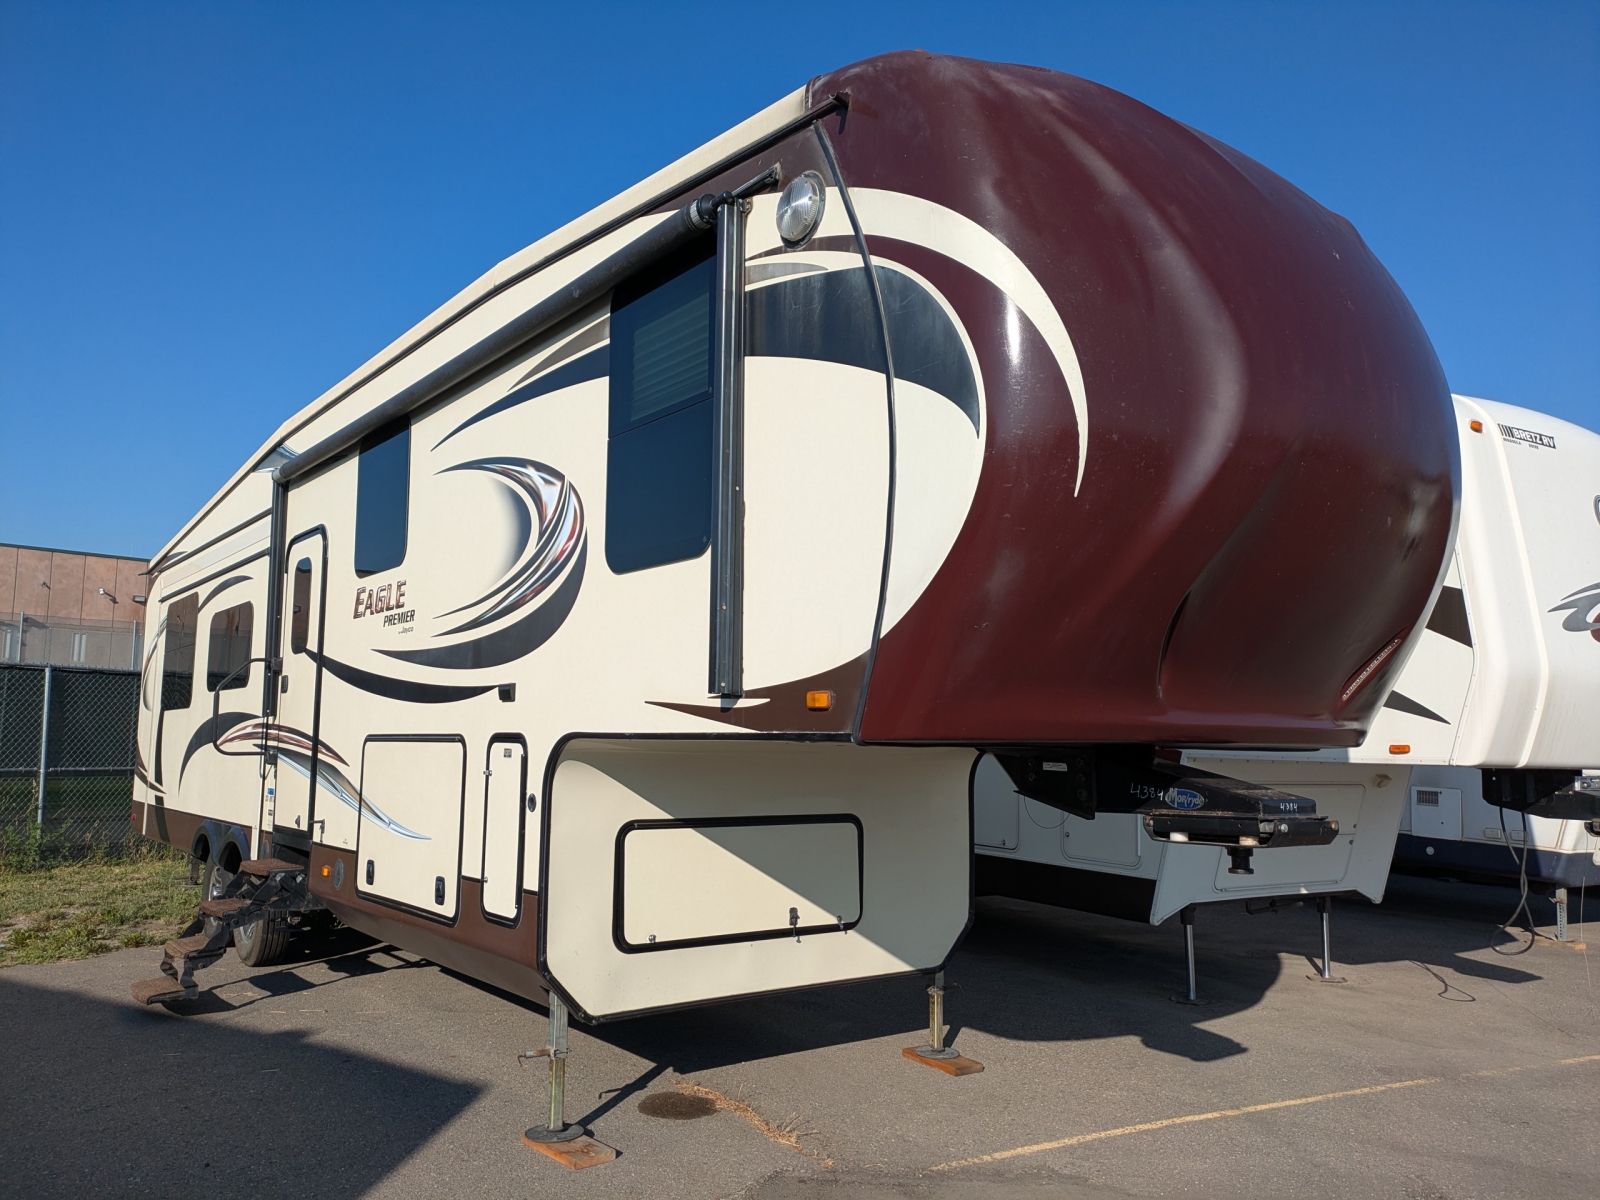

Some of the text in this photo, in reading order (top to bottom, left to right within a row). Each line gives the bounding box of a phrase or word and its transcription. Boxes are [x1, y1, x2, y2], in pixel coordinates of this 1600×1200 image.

[1512, 428, 1555, 448] BRETZ RV
[353, 579, 407, 619] EAGLE
[383, 609, 416, 627] PREMIER
[1130, 783, 1164, 801] 4384
[1280, 802, 1298, 812] 4384
